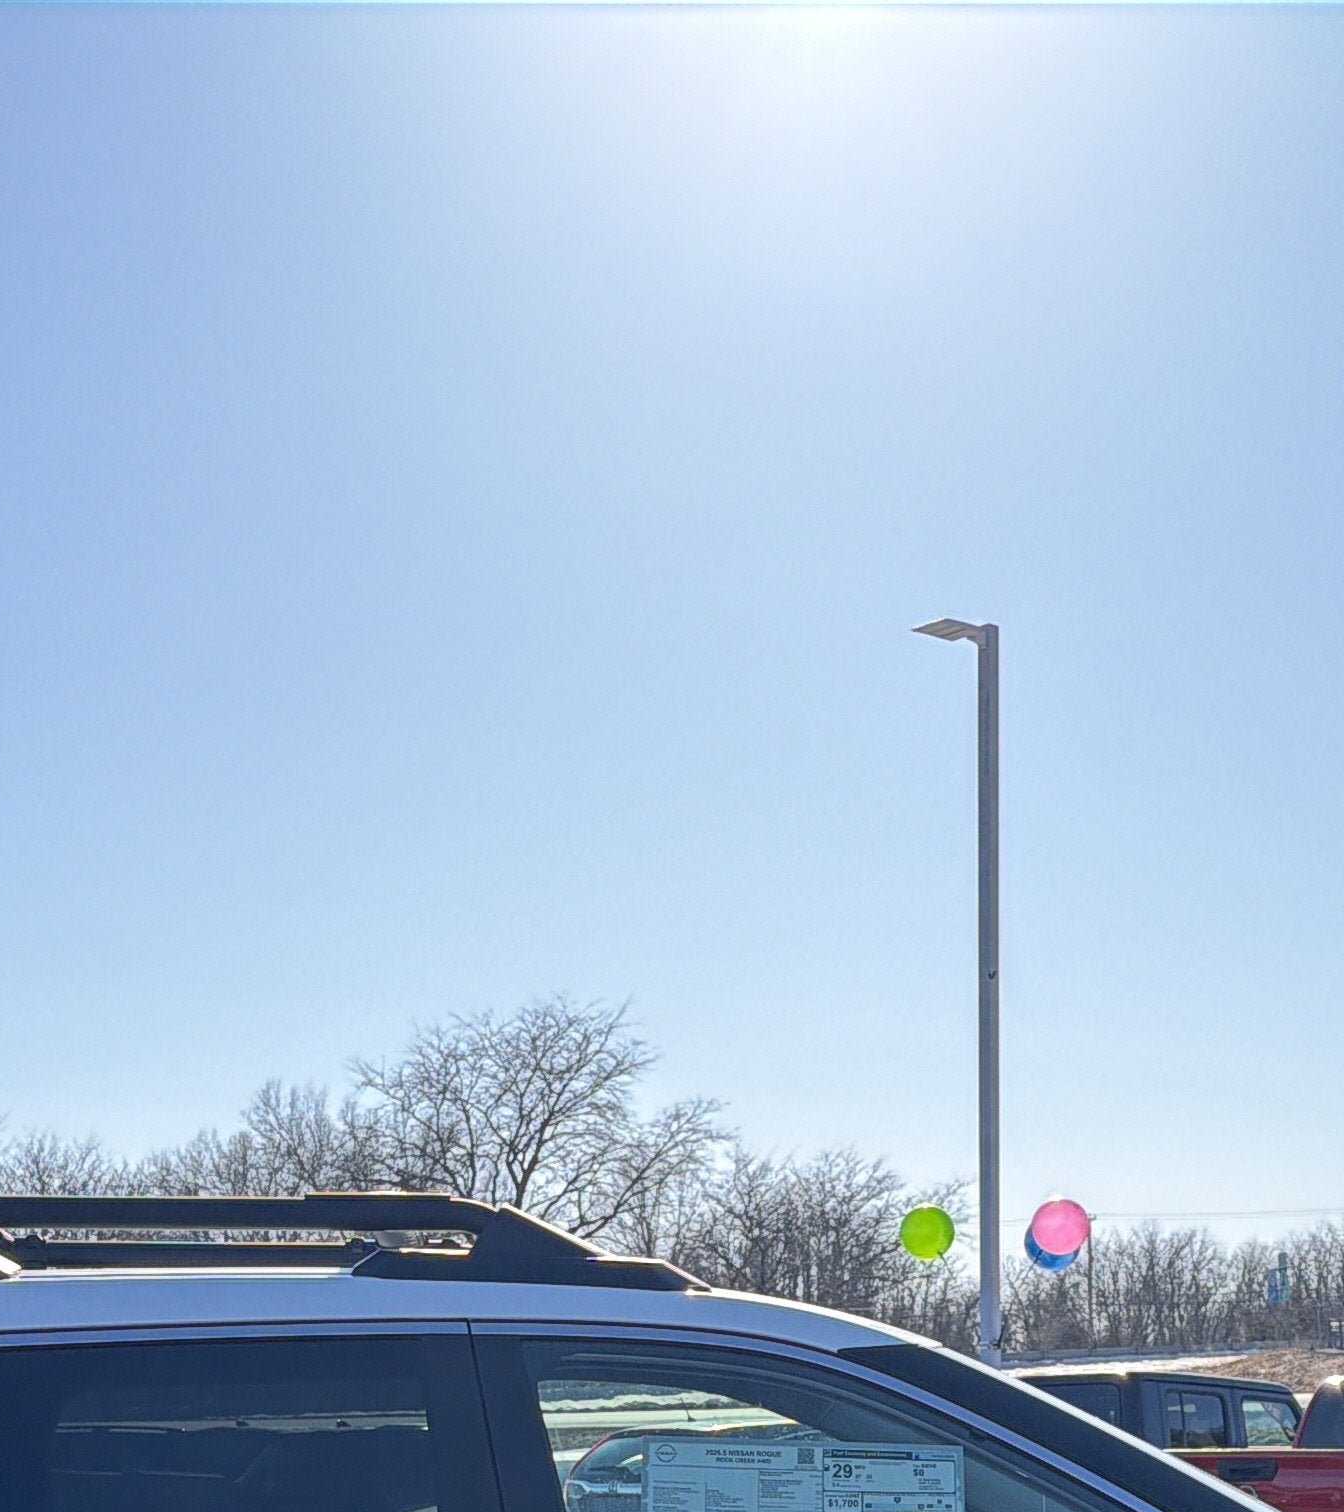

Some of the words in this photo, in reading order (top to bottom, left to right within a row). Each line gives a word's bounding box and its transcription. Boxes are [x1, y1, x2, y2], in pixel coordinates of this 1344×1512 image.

[728, 1449, 754, 1457] NISSAN
[832, 1463, 853, 1479] 29
[913, 1468, 925, 1477] $0
[828, 1498, 859, 1509] $1,700
